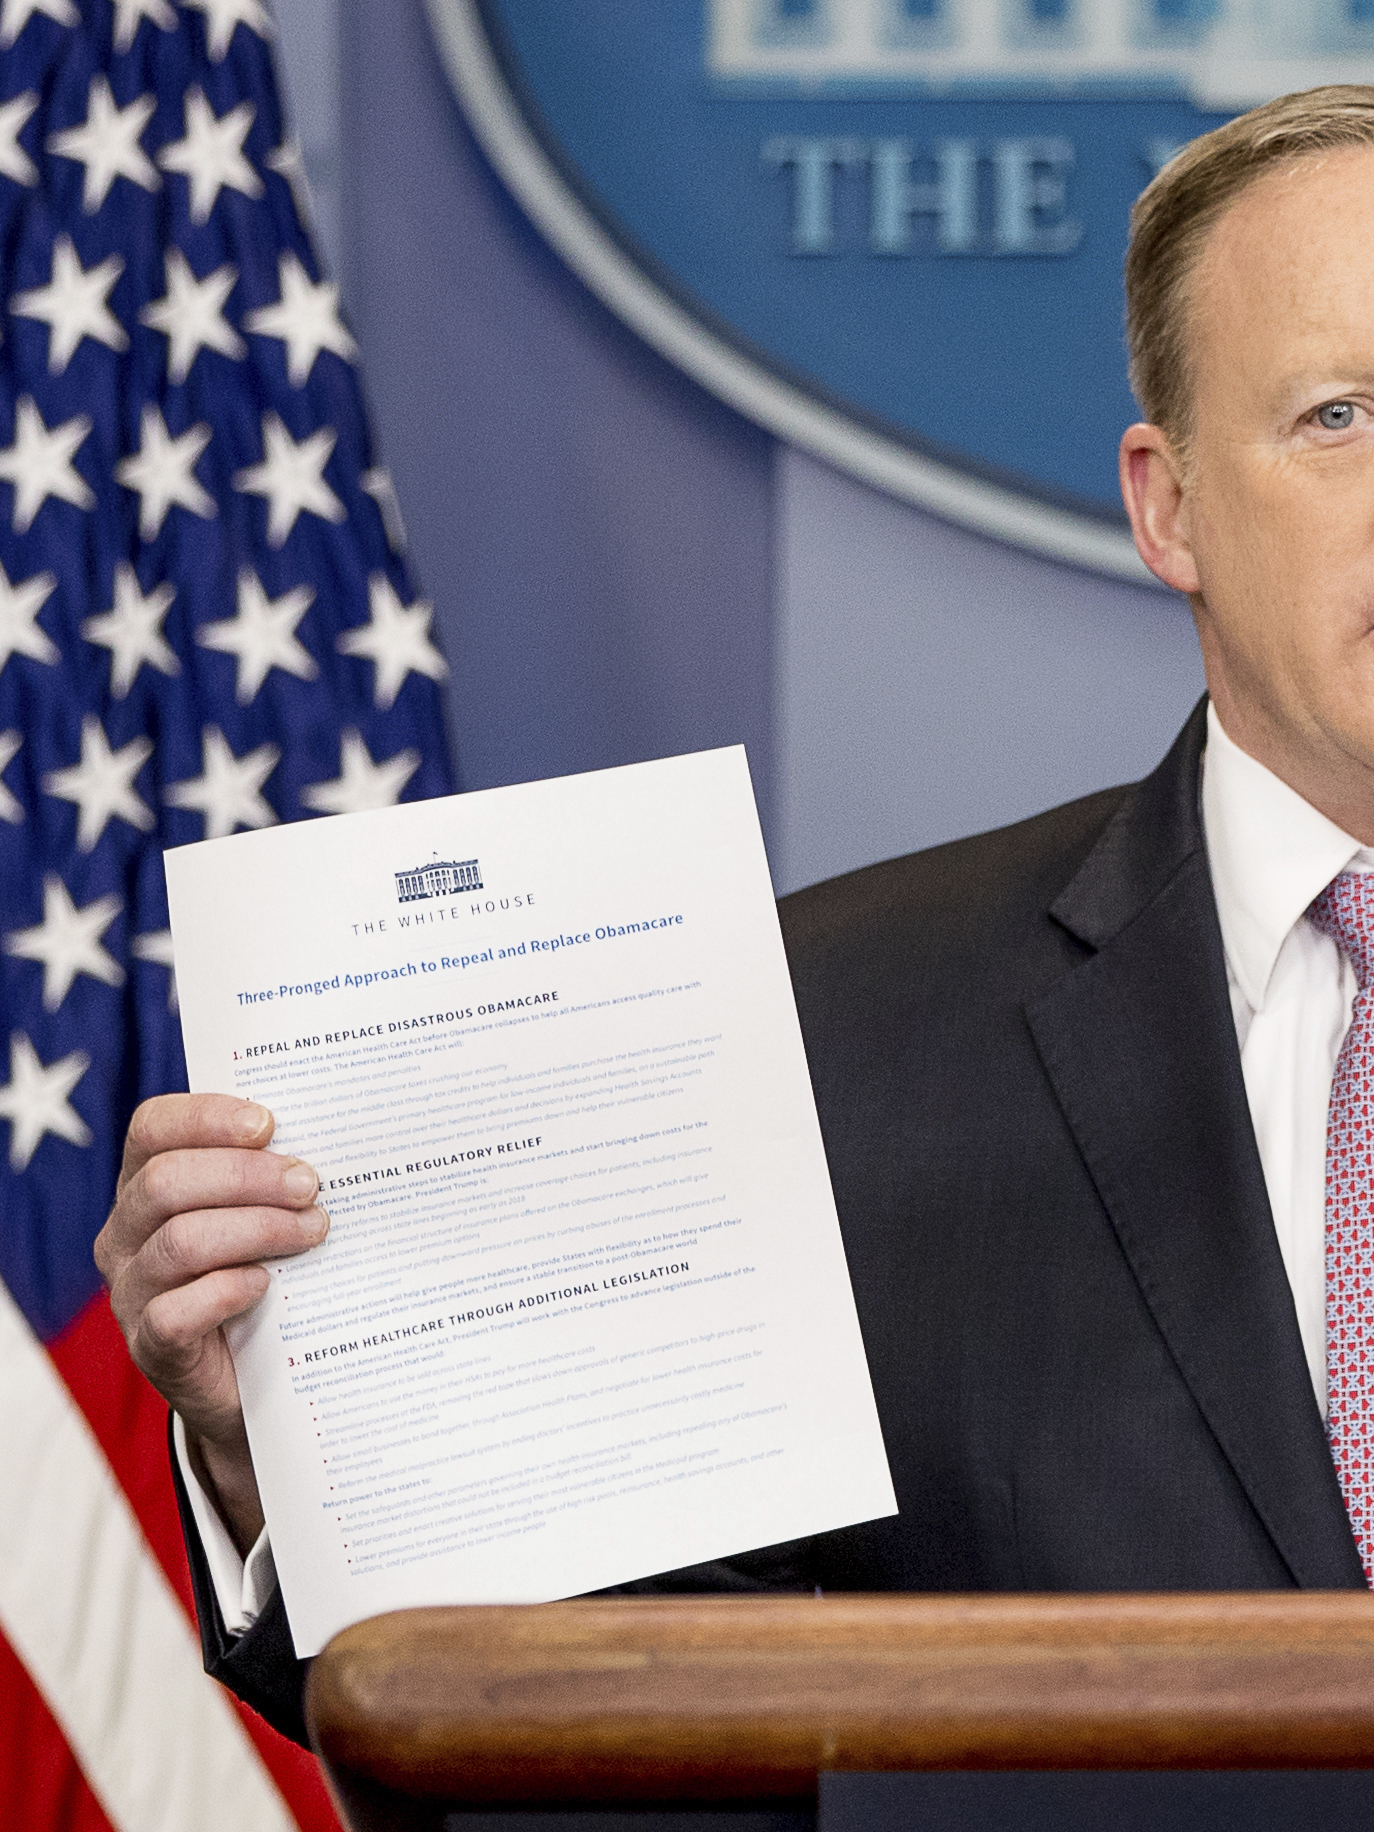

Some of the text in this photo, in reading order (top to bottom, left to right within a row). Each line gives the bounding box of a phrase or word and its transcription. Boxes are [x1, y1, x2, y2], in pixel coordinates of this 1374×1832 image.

[760, 134, 1083, 253] THE
[352, 893, 535, 936] THE WHITE HOUSE
[237, 914, 683, 1006] Three-Pronged Approach to Repeal and Replace Obamacare
[233, 990, 560, 1061] 1. REPEAL AND REPLACE DISASTROUS OBAMACARE
[234, 1066, 263, 1077] Congress
[263, 1060, 288, 1071] should
[288, 1057, 310, 1067] enact
[310, 1055, 324, 1063] the
[325, 1048, 362, 1060] American
[362, 1042, 389, 1053] Health
[389, 1040, 408, 1049] Care
[408, 1037, 422, 1045] Act
[422, 1032, 448, 1043] before
[448, 1023, 493, 1037] Obamacare
[494, 1016, 531, 1028] collapses
[540, 1010, 559, 1019] help
[559, 1006, 570, 1016] all
[570, 1000, 611, 1013] Americans
[612, 994, 637, 1005] access
[637, 989, 665, 1001] quality
[666, 985, 683, 994] care
[683, 980, 702, 990] with
[235, 1080, 252, 1088] more
[252, 1075, 279, 1085] choices
[279, 1073, 287, 1081] at
[287, 1070, 309, 1079] lower
[334, 1062, 349, 1071] The
[350, 1056, 387, 1068] American
[387, 1050, 414, 1061] Health
[414, 1047, 433, 1056] Care
[433, 1044, 447, 1052] Act
[325, 1195, 351, 1206] taking
[351, 1184, 407, 1201] administrative
[407, 1179, 429, 1189] steps
[439, 1170, 472, 1182] stabilize
[472, 1164, 498, 1175] health
[498, 1156, 536, 1169] insurance
[536, 1149, 569, 1161] markets
[570, 1145, 585, 1155] and
[585, 1142, 604, 1152] start
[604, 1135, 639, 1148] bringing
[638, 1131, 661, 1141] down
[661, 1127, 682, 1136] costs
[694, 1121, 708, 1129] the
[329, 1166, 402, 1190] ESSENTIAL
[405, 1146, 492, 1174] REGULATORY
[496, 1136, 542, 1155] RELIEF
[415, 1184, 453, 1198] President
[453, 1179, 479, 1190] Trump
[278, 1320, 304, 1331] Future
[306, 1305, 359, 1325] administrative
[361, 1298, 388, 1311] actions
[388, 1293, 403, 1303] will
[403, 1290, 421, 1299] help
[421, 1286, 437, 1297] give
[438, 1279, 465, 1292] people
[465, 1274, 486, 1284] more
[531, 1257, 561, 1270] provide
[561, 1251, 587, 1262] States
[587, 1246, 605, 1257] with
[605, 1240, 642, 1252] flexibility
[643, 1237, 652, 1245] as
[662, 1232, 679, 1240] how
[680, 1228, 698, 1237] they
[698, 1220, 723, 1233] spend
[723, 1218, 742, 1227] their
[281, 1328, 317, 1342] Medicaid
[317, 1322, 344, 1334] dollars
[344, 1317, 359, 1327] and
[359, 1310, 391, 1323] regulate
[391, 1305, 409, 1314] their
[410, 1295, 447, 1309] insurance
[483, 1282, 498, 1292] and
[498, 1277, 525, 1288] ensure
[532, 1269, 556, 1281] stable
[556, 1261, 595, 1275] transition
[594, 1259, 604, 1267] to
[675, 1237, 698, 1249] world
[287, 1261, 690, 1368] 3. REFORM HEALTHCARE THROUGH ADDITIONAL LEGISLATION
[301, 1368, 333, 1381] addition
[333, 1365, 343, 1373] to
[343, 1362, 356, 1370] the
[357, 1352, 393, 1366] American
[392, 1345, 418, 1357] Health
[418, 1341, 436, 1351] Care
[452, 1327, 489, 1342] President
[489, 1321, 515, 1332] Trump
[515, 1316, 531, 1326] will
[531, 1312, 551, 1322] work
[551, 1308, 569, 1318] with
[569, 1305, 583, 1313] the
[584, 1296, 620, 1310] Congress
[619, 1294, 629, 1302] to
[630, 1287, 662, 1299] advance
[662, 1277, 703, 1292] legislation
[703, 1271, 733, 1283] outside
[733, 1267, 742, 1277] of
[742, 1266, 756, 1274] the
[293, 1382, 322, 1395] budget
[322, 1369, 374, 1387] reconciliation
[374, 1362, 404, 1376] process
[403, 1357, 420, 1367] that
[322, 1499, 348, 1509] Return
[348, 1492, 373, 1505] power
[383, 1486, 397, 1495] the
[398, 1480, 421, 1491] states
